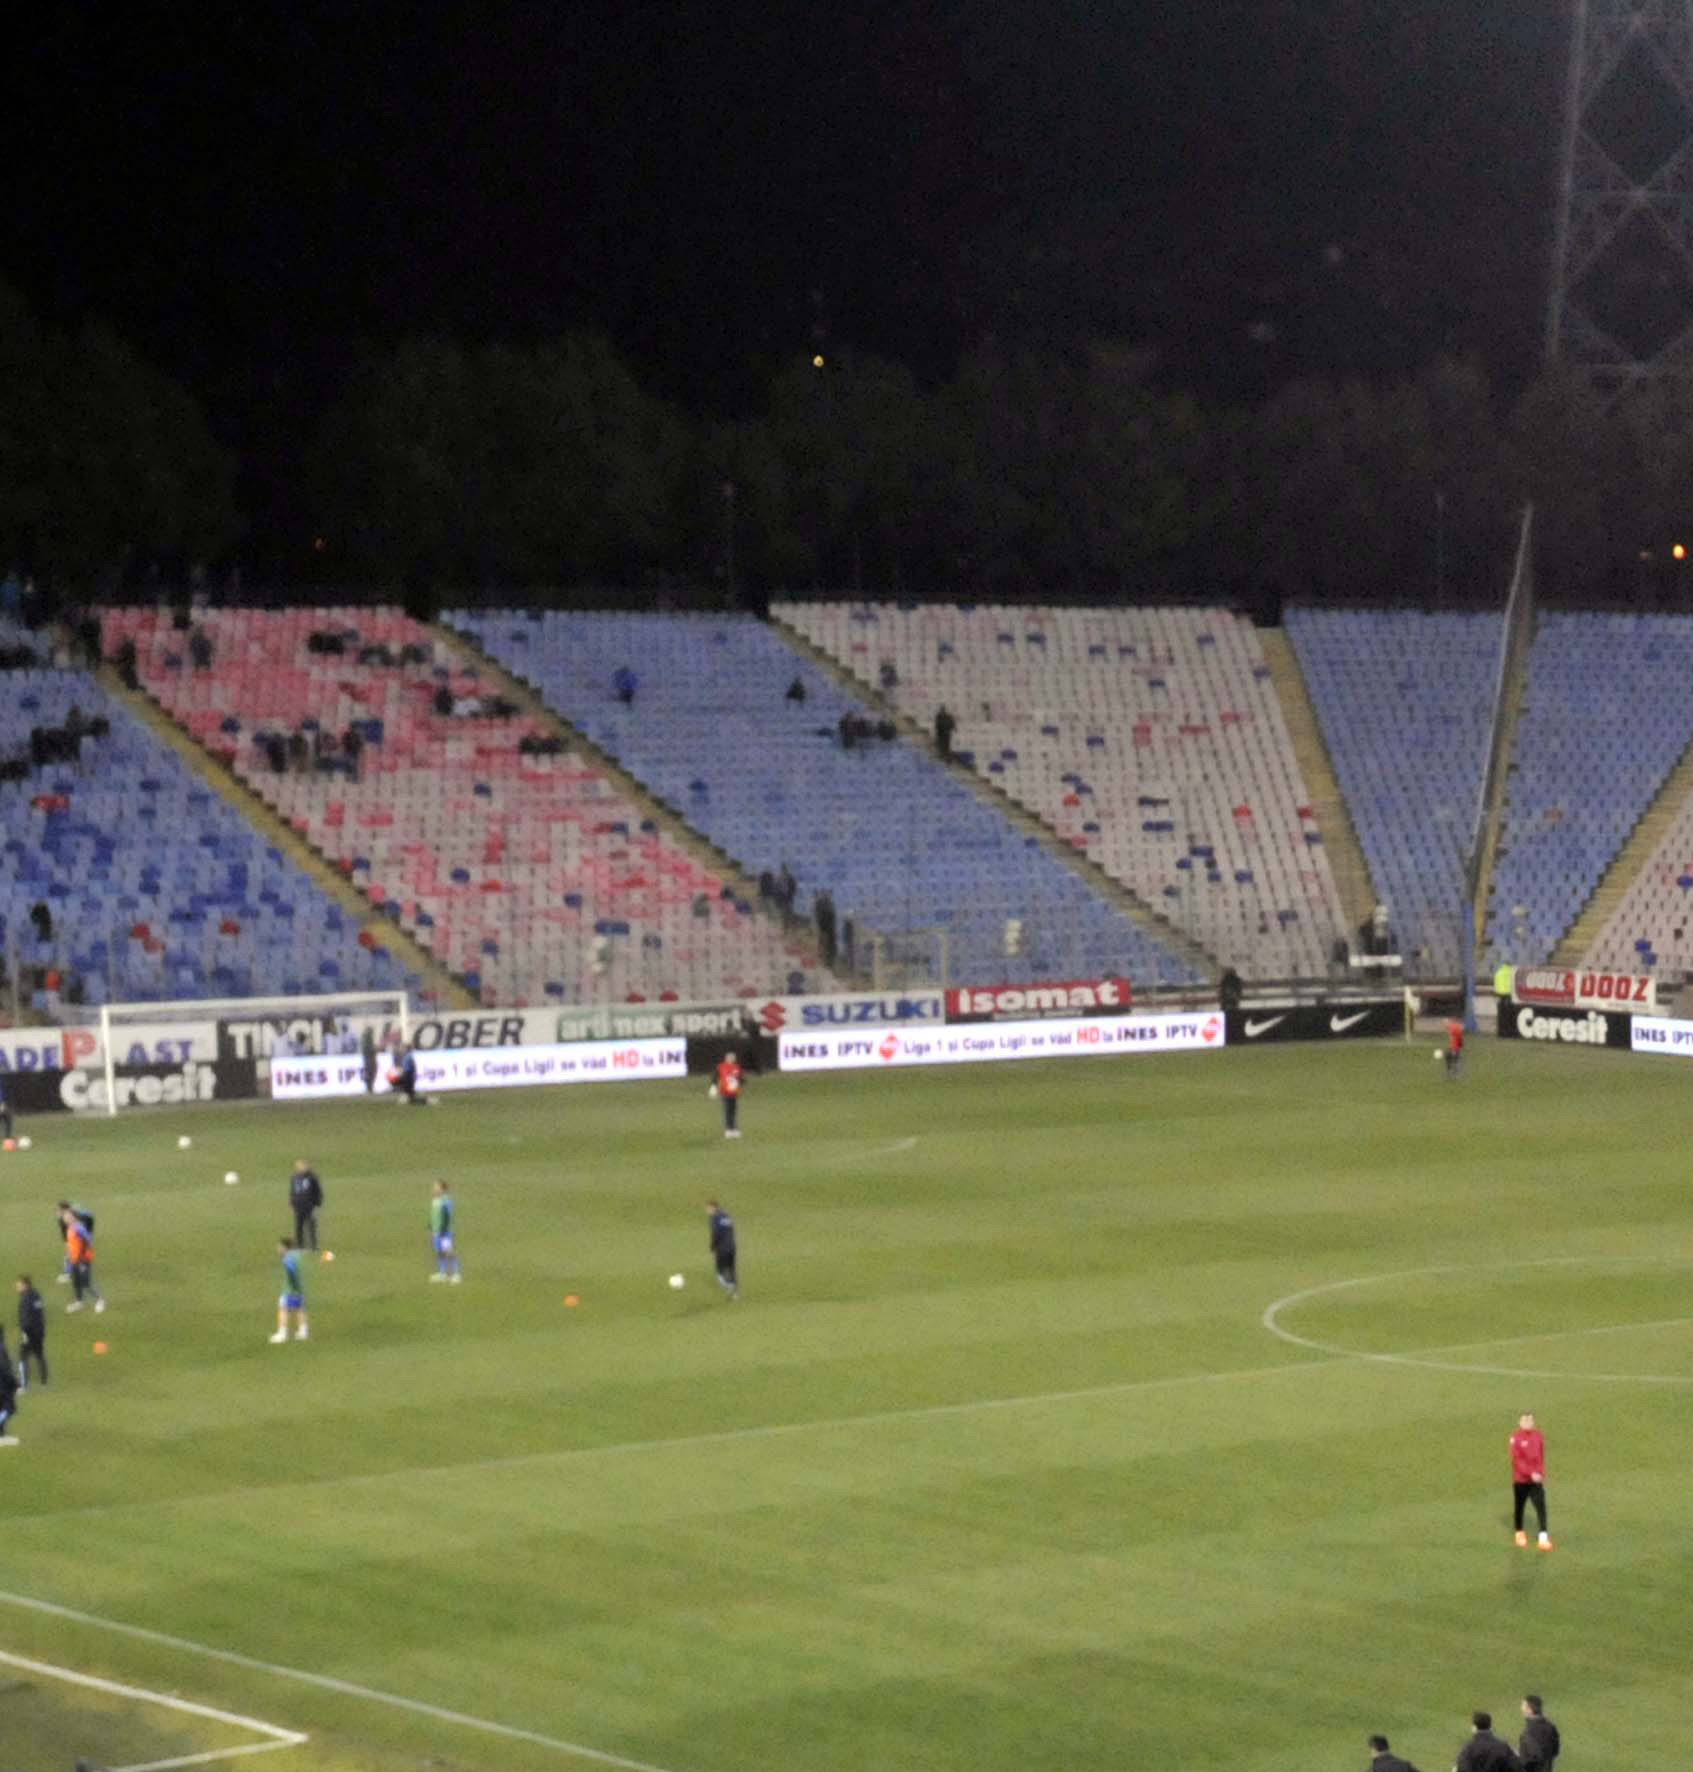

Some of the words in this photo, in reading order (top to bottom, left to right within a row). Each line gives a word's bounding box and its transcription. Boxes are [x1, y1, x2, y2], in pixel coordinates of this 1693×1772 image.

[801, 998, 941, 1026] SUZUKI
[1517, 1007, 1608, 1045] Ceresit
[0, 1029, 194, 1072] ADEPAST
[838, 1041, 873, 1056] IPTV
[904, 1040, 930, 1056] Liga
[963, 1038, 994, 1051] Cupa
[1031, 1036, 1044, 1046] se
[1076, 1028, 1099, 1044] HD
[1165, 1024, 1198, 1039] IPTV
[613, 1050, 640, 1069] HD
[60, 1061, 217, 1109] Ceresit
